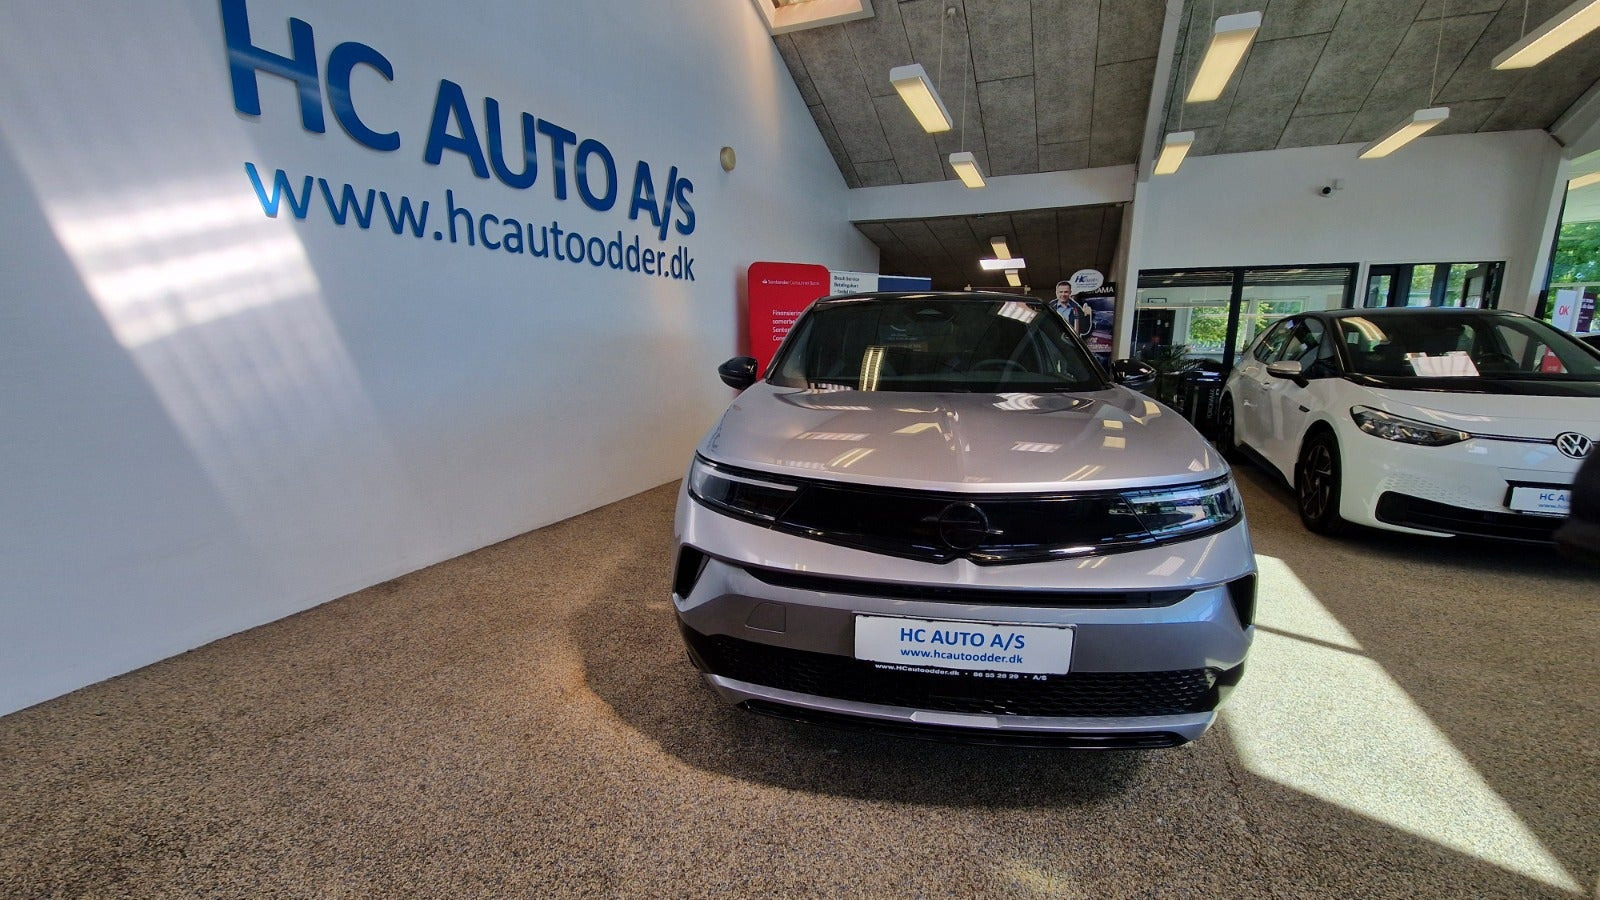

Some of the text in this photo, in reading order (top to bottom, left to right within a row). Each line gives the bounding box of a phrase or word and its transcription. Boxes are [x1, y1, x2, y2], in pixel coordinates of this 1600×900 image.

[220, 0, 697, 241] HC AUTO A/S
[245, 161, 696, 282] www.hcautoodder.dk
[1540, 493, 1555, 501] HC
[900, 628, 1025, 651] HC AUTO A/S
[900, 649, 1023, 664] www.hcautoodder.dk
[875, 663, 960, 676] www.HCautoodder.dk
